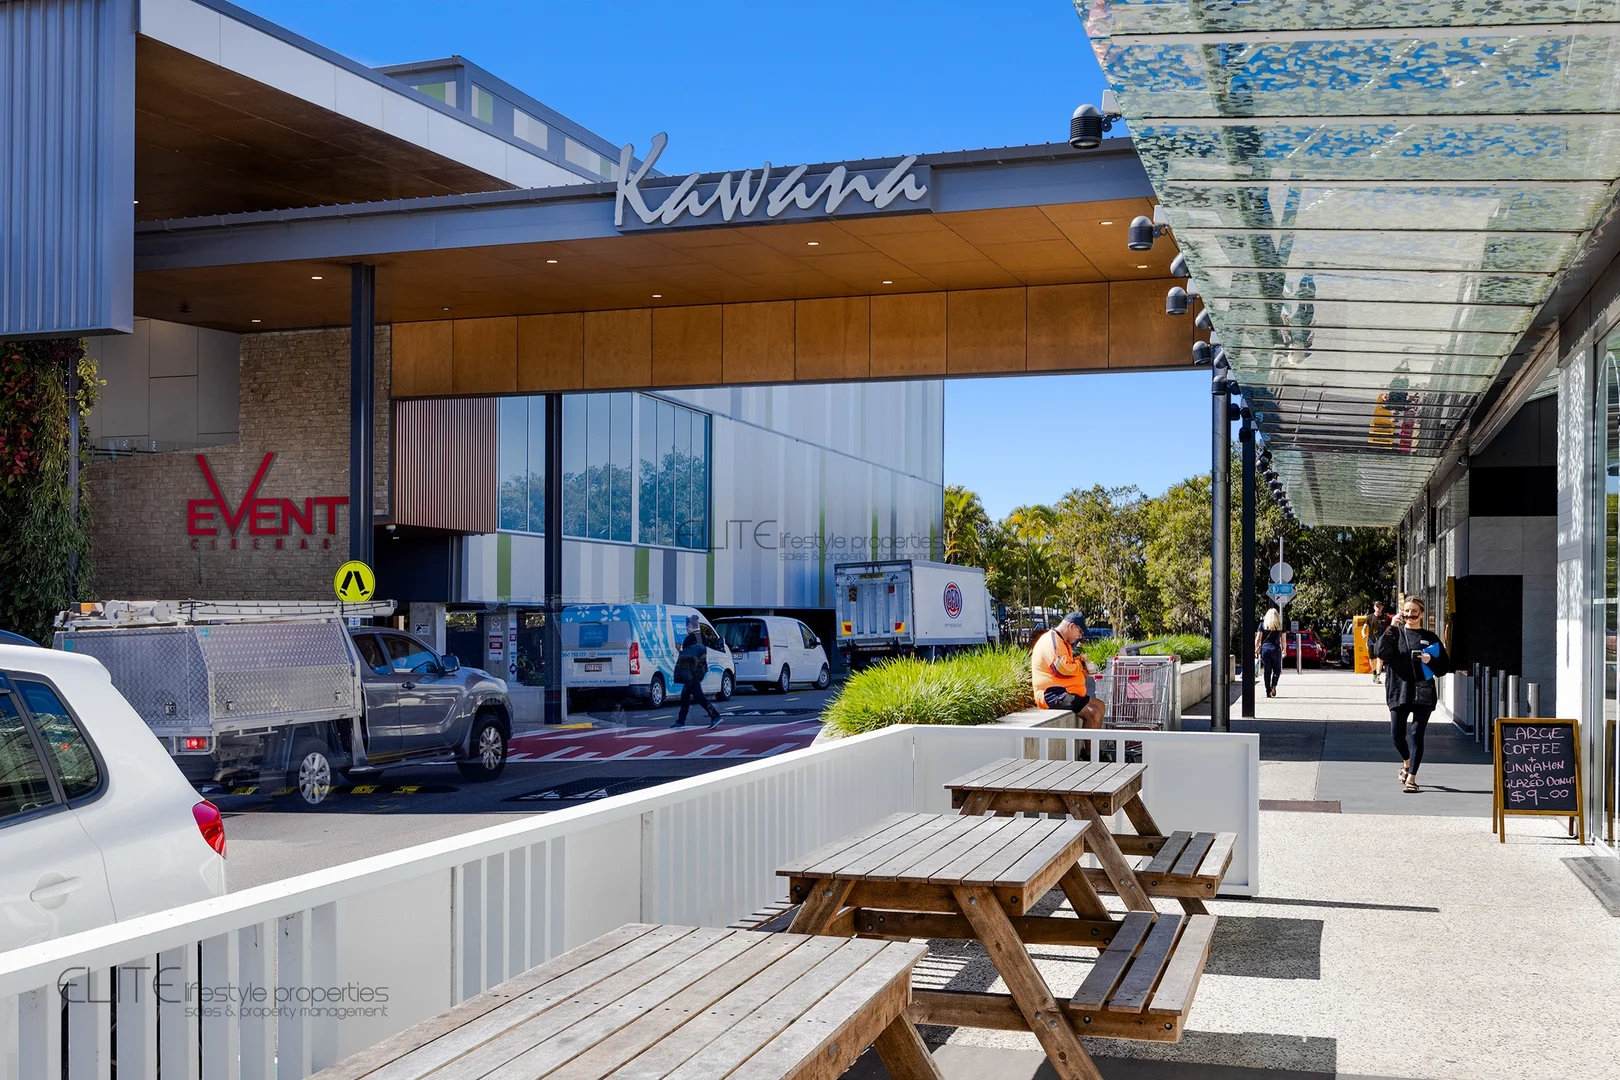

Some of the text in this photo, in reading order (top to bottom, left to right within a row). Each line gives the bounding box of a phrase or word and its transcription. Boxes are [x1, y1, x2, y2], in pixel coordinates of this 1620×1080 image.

[614, 131, 928, 226] Kawana
[187, 452, 349, 536] EVENT
[190, 538, 331, 549] CINEMAS
[1503, 725, 1565, 741] LARGE
[1502, 742, 1561, 755] COFFEE
[1503, 760, 1565, 773] CINNAMON
[1504, 775, 1575, 789] GLAZED DONUT
